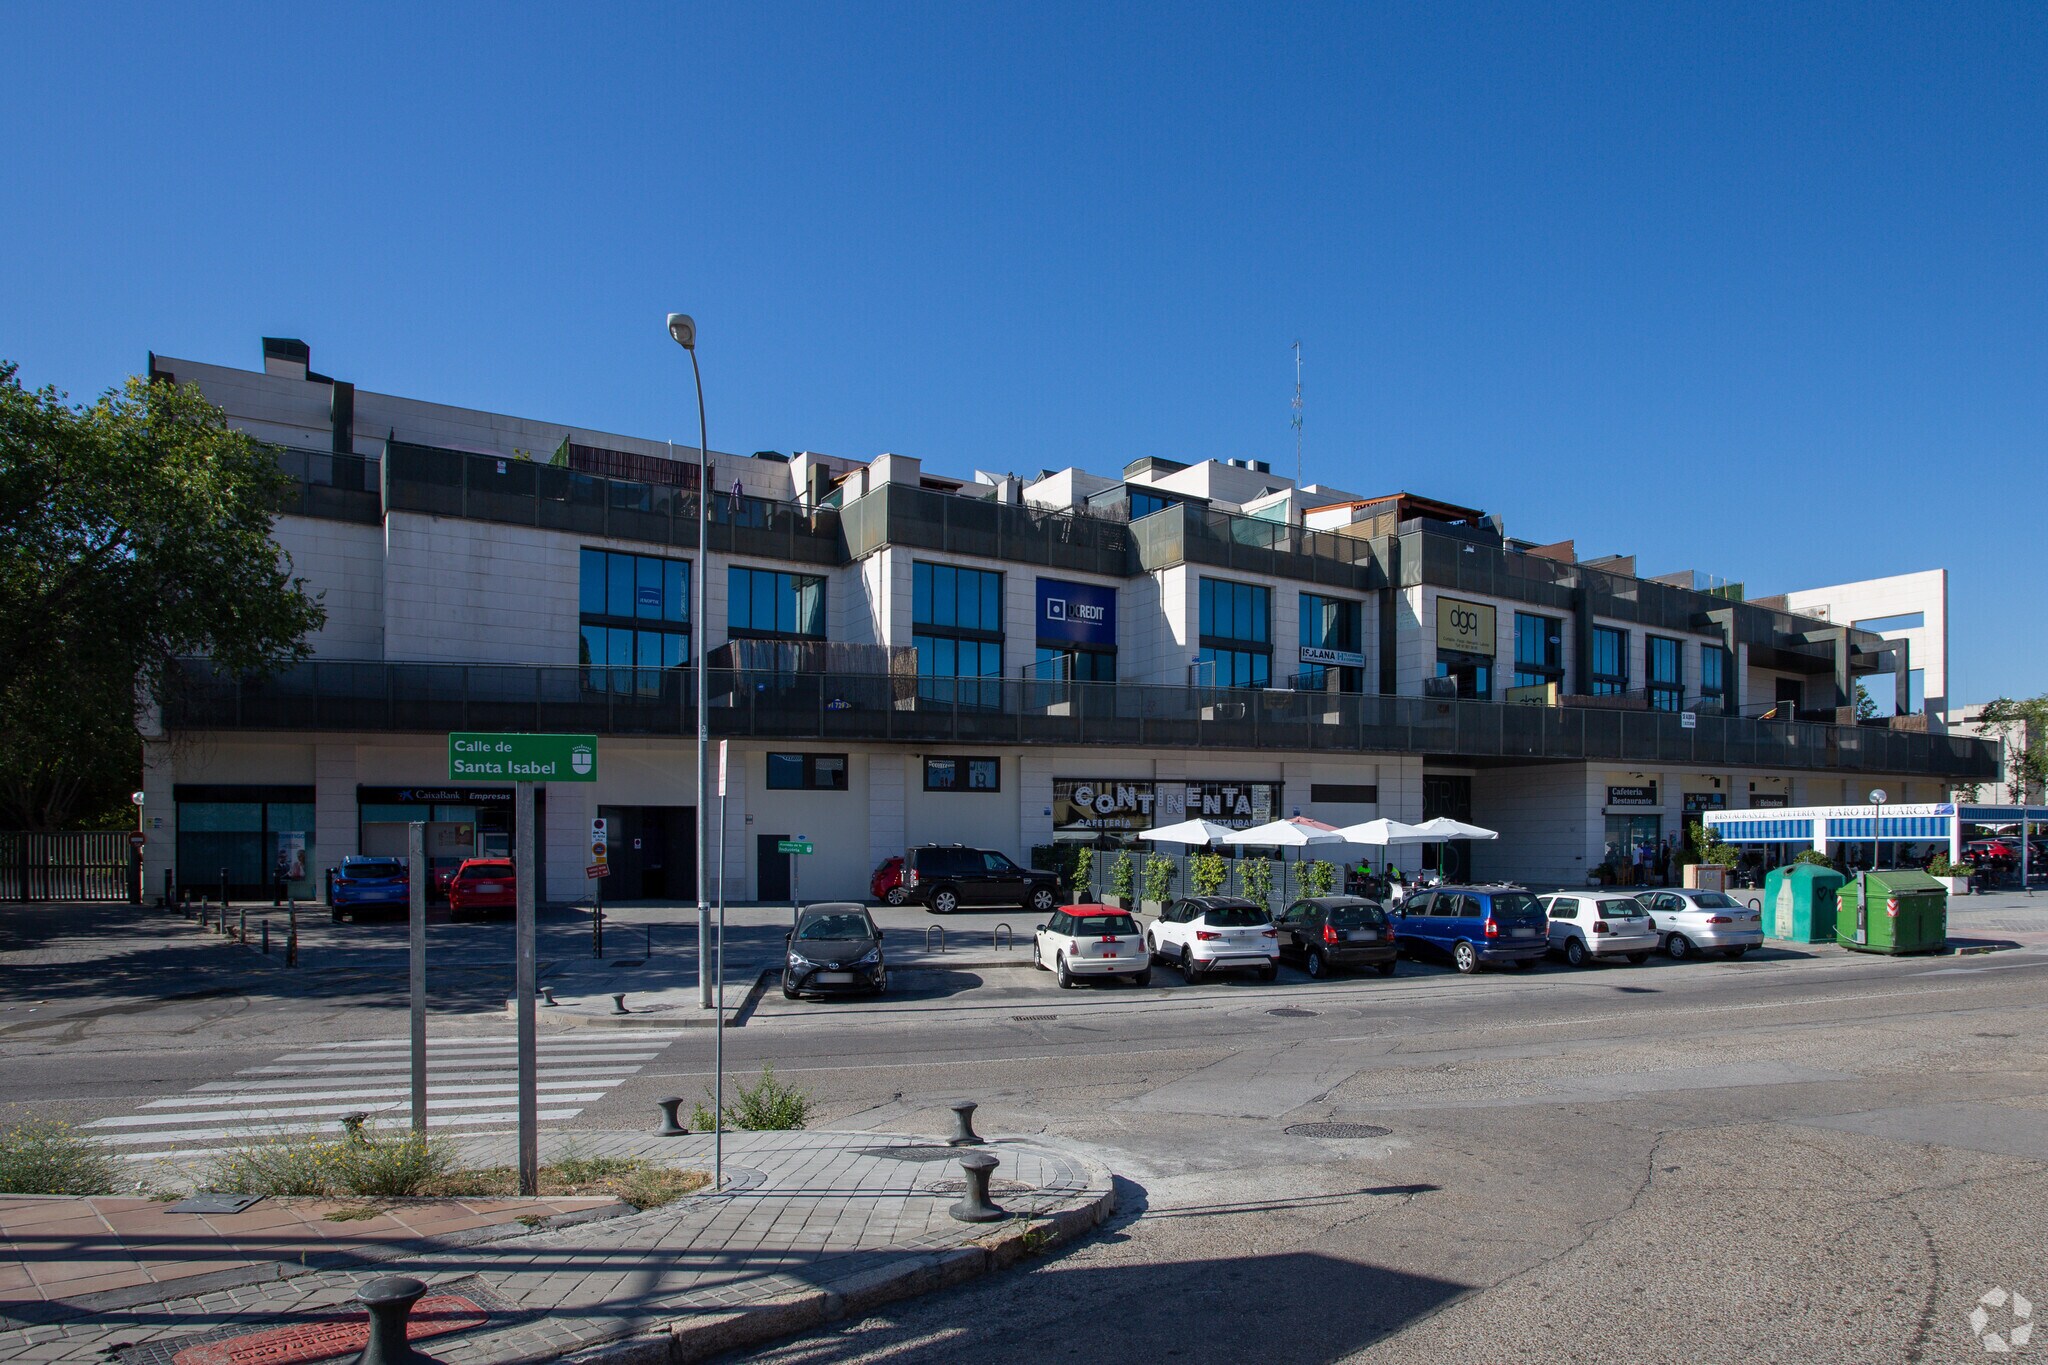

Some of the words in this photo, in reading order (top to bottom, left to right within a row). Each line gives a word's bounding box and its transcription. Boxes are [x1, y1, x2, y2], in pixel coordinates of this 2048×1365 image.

[1450, 604, 1477, 637] dgq
[1302, 648, 1336, 660] ISOLANA
[454, 740, 491, 752] Calle
[495, 741, 513, 752] de
[454, 759, 503, 773] Santa
[507, 760, 556, 774] Isabel
[416, 790, 460, 799] CaixaBank
[469, 792, 510, 800] Empresas
[1075, 786, 1267, 814] CONTINENTAL
[1612, 796, 1653, 805] Restaurante
[1828, 807, 1859, 817] FARO
[1881, 805, 1931, 816] LUARCA
[1077, 818, 1132, 828] CAFETERÍA
